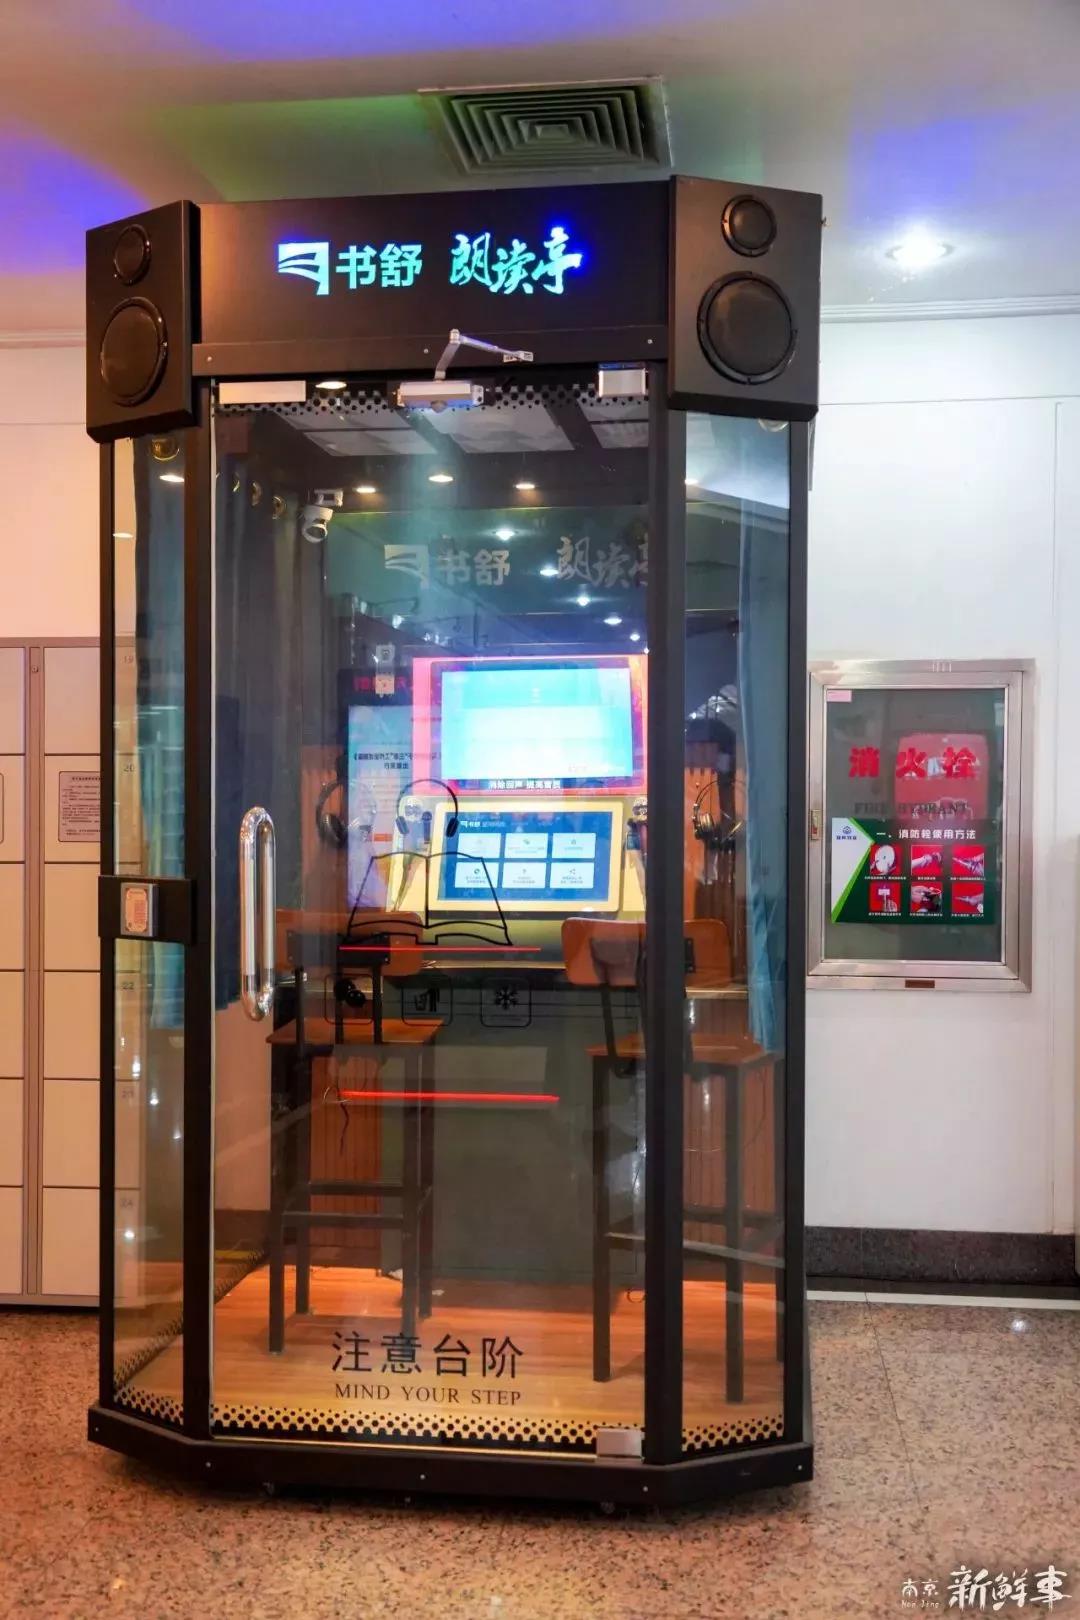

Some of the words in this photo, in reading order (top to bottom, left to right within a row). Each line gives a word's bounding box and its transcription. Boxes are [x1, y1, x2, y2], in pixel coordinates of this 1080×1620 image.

[336, 243, 423, 289] 书舒
[450, 226, 582, 295] 朗读亭
[848, 747, 977, 777] 消火栓
[332, 1331, 524, 1379] 注意台阶
[335, 1383, 390, 1400] MIND
[401, 1385, 460, 1404] YOUR
[471, 1389, 521, 1406] STEP
